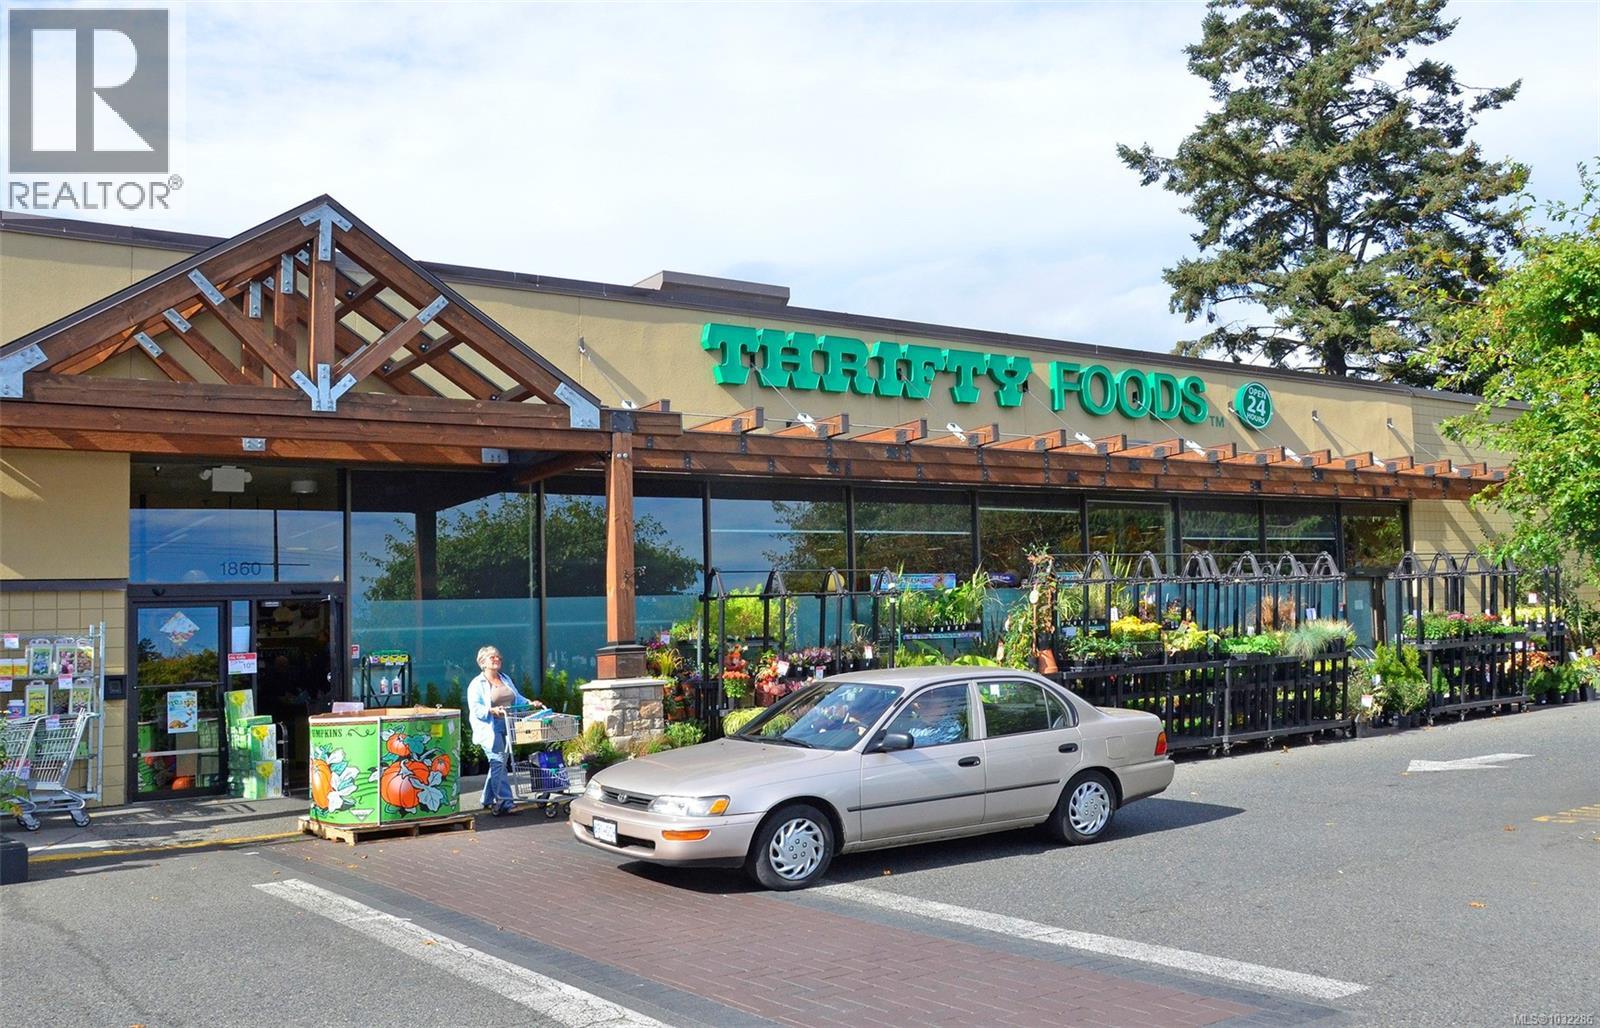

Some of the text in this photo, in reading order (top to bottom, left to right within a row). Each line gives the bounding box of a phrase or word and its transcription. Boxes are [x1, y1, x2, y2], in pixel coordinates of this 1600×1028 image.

[701, 322, 1032, 407] THRIFTY
[1049, 360, 1209, 425] FOODS
[1248, 386, 1267, 400] OPEN
[1247, 395, 1266, 416] 24
[1246, 411, 1266, 424] HOURS
[219, 561, 262, 576] 1860
